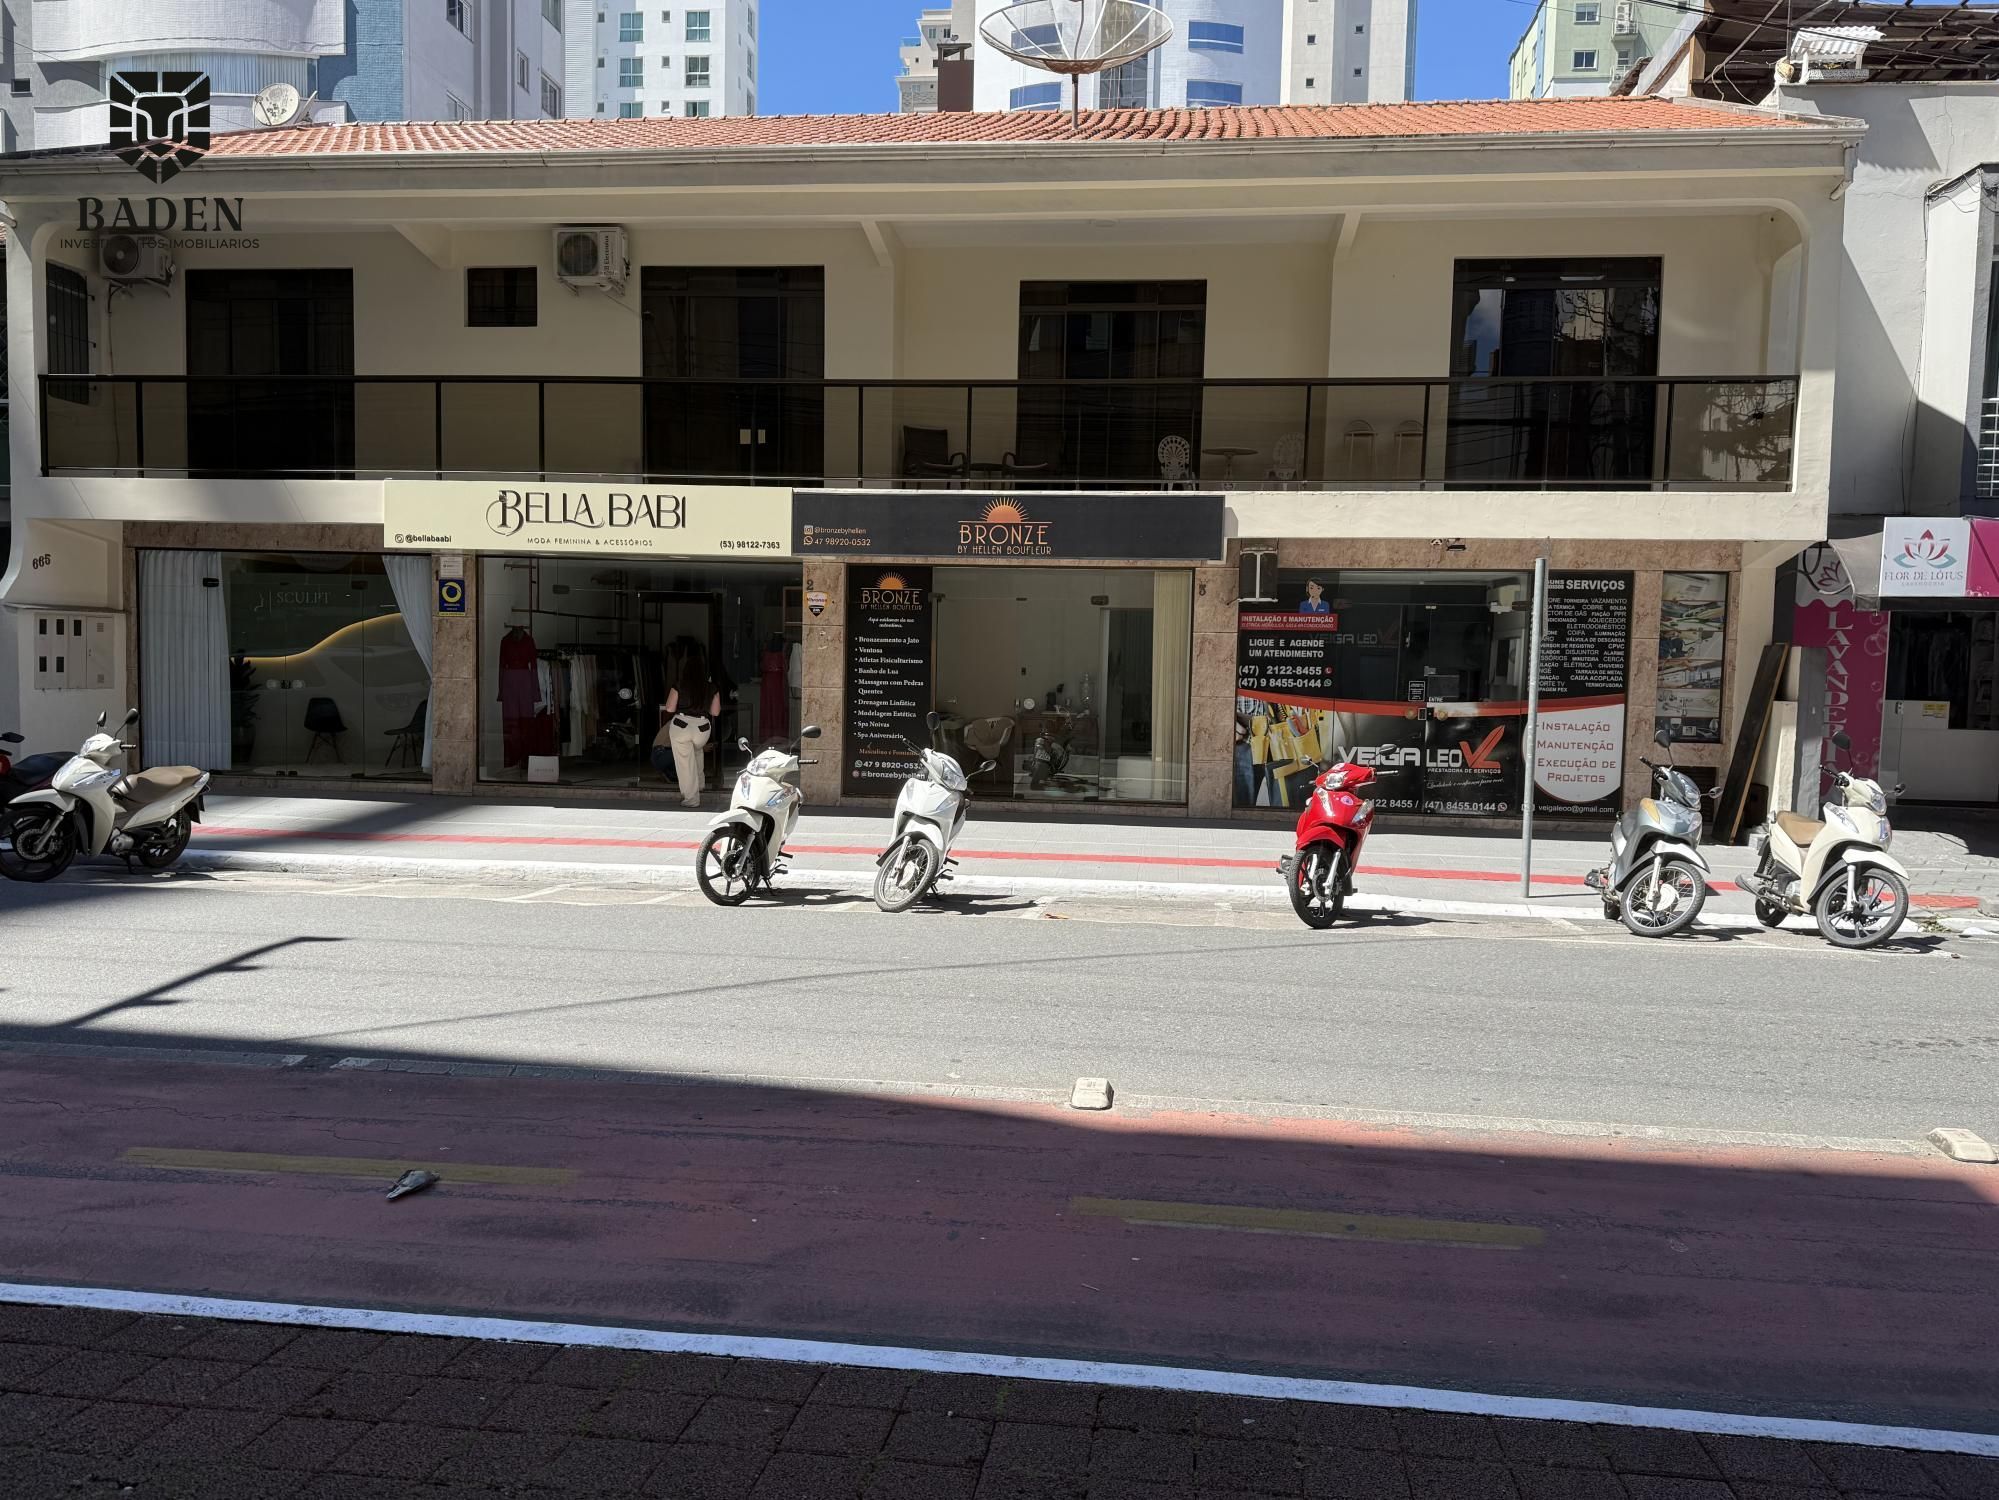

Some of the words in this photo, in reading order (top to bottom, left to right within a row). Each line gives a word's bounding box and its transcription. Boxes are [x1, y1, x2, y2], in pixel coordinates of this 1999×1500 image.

[486, 489, 605, 537] BELLA
[608, 493, 686, 529] BABI
[405, 533, 452, 544] @bellabaabi
[959, 524, 1049, 545] BRONZE
[527, 537, 552, 545] MODA
[554, 537, 592, 545] FEMININA
[603, 538, 653, 547] ACESSÓRIOS
[720, 540, 735, 550] (53)
[736, 540, 780, 549] 98122-7363
[825, 537, 872, 546] 98920-0532
[957, 545, 968, 554] BY
[972, 545, 1002, 555] HELLEN
[1006, 545, 1052, 555] BOUFLEUR
[1884, 571, 1910, 581] FLOR
[1913, 571, 1927, 581] DE
[806, 579, 814, 591] 2
[1566, 579, 1625, 593] SERVIÇOS
[862, 590, 920, 604] BRONZE
[1574, 609, 1588, 617] GÁS
[1241, 615, 1282, 624] INSTALAÇÃO
[1288, 616, 1334, 624] MANUTENÇÃO
[1566, 622, 1626, 630] ELETRODOMÉSTICO
[906, 637, 920, 645] Jato
[1249, 639, 1275, 647] LIGUE
[1289, 640, 1325, 648] AGENDE
[1264, 650, 1324, 658] ATENDIMENTO
[1563, 660, 1593, 668] ELÉTRICA
[879, 667, 887, 675] de
[1238, 665, 1259, 677] (47)
[1266, 665, 1322, 675] 2122-8455
[858, 679, 889, 687] Massagem
[1238, 678, 1258, 689] (47)
[1260, 679, 1267, 687] 9
[1269, 678, 1321, 688] 8455-0144
[858, 699, 889, 707] Drenagem
[857, 709, 892, 718] Modelagem
[857, 721, 869, 729] Spa
[1542, 721, 1611, 734] INSTALAÇÃO
[1537, 740, 1614, 754] MANUTENÇÃO
[1337, 745, 1421, 767] VEIGA
[1426, 748, 1462, 768] LEO
[1537, 757, 1597, 771] EXECUÇÃO
[1601, 761, 1617, 769] DE
[1547, 772, 1606, 783] PROJETOS
[1389, 799, 1413, 808] 8455
[1424, 800, 1444, 811] (47)
[1446, 800, 1496, 812] 8455.0144
[1538, 804, 1615, 813] veigaleoo@gmail.com
